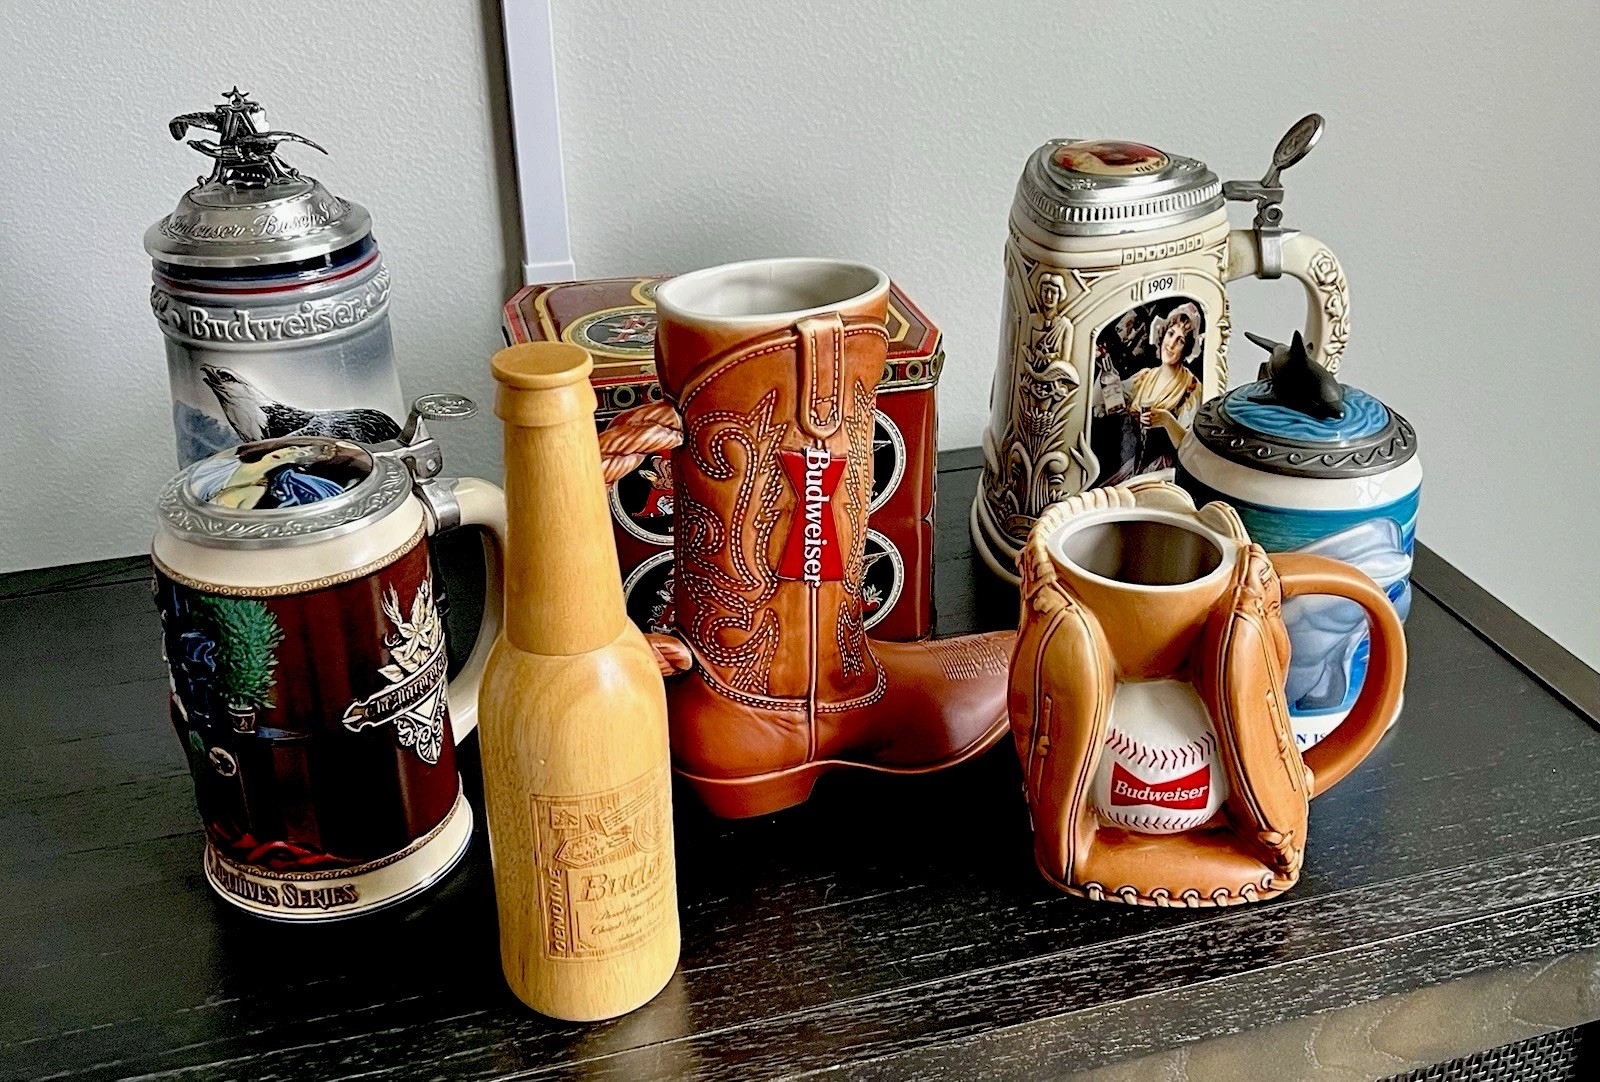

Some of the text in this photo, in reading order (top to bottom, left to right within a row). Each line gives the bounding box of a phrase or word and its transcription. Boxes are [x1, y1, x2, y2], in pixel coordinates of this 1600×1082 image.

[1148, 276, 1173, 294] 1909
[803, 446, 832, 588] Budweiser
[1113, 780, 1209, 802] Budweiser
[547, 866, 567, 952] GENUINE
